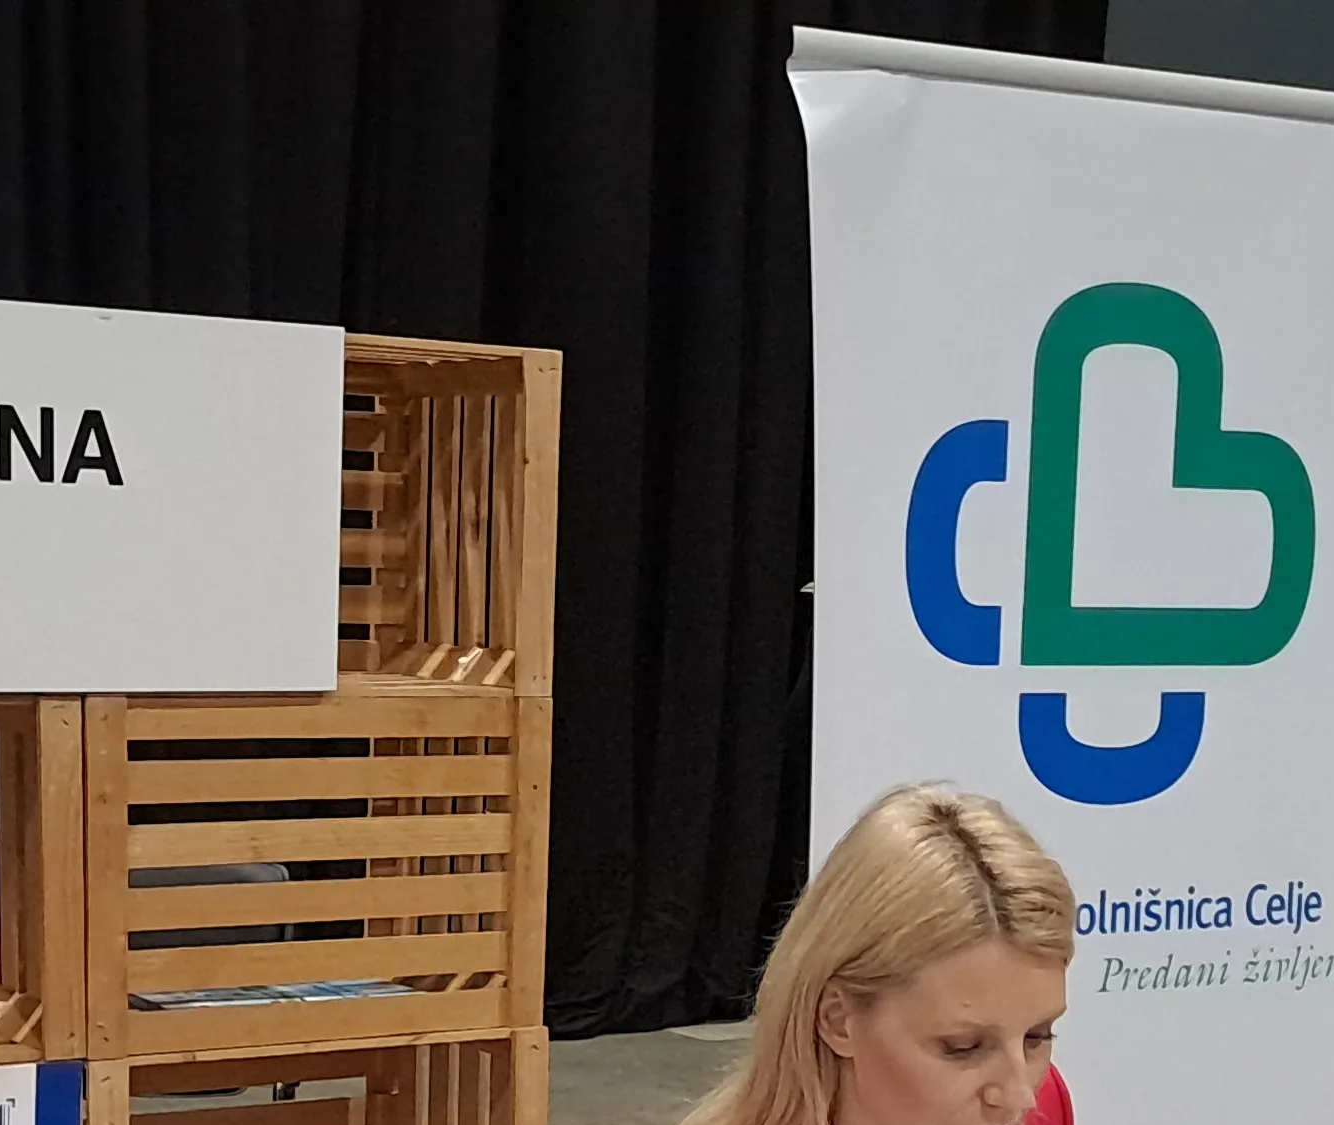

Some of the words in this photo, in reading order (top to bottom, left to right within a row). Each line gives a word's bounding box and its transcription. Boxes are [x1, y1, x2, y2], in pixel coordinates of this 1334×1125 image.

[1074, 886, 1233, 935] olnišnica
[1245, 880, 1323, 935] Celje
[1097, 949, 1233, 993] Predani
